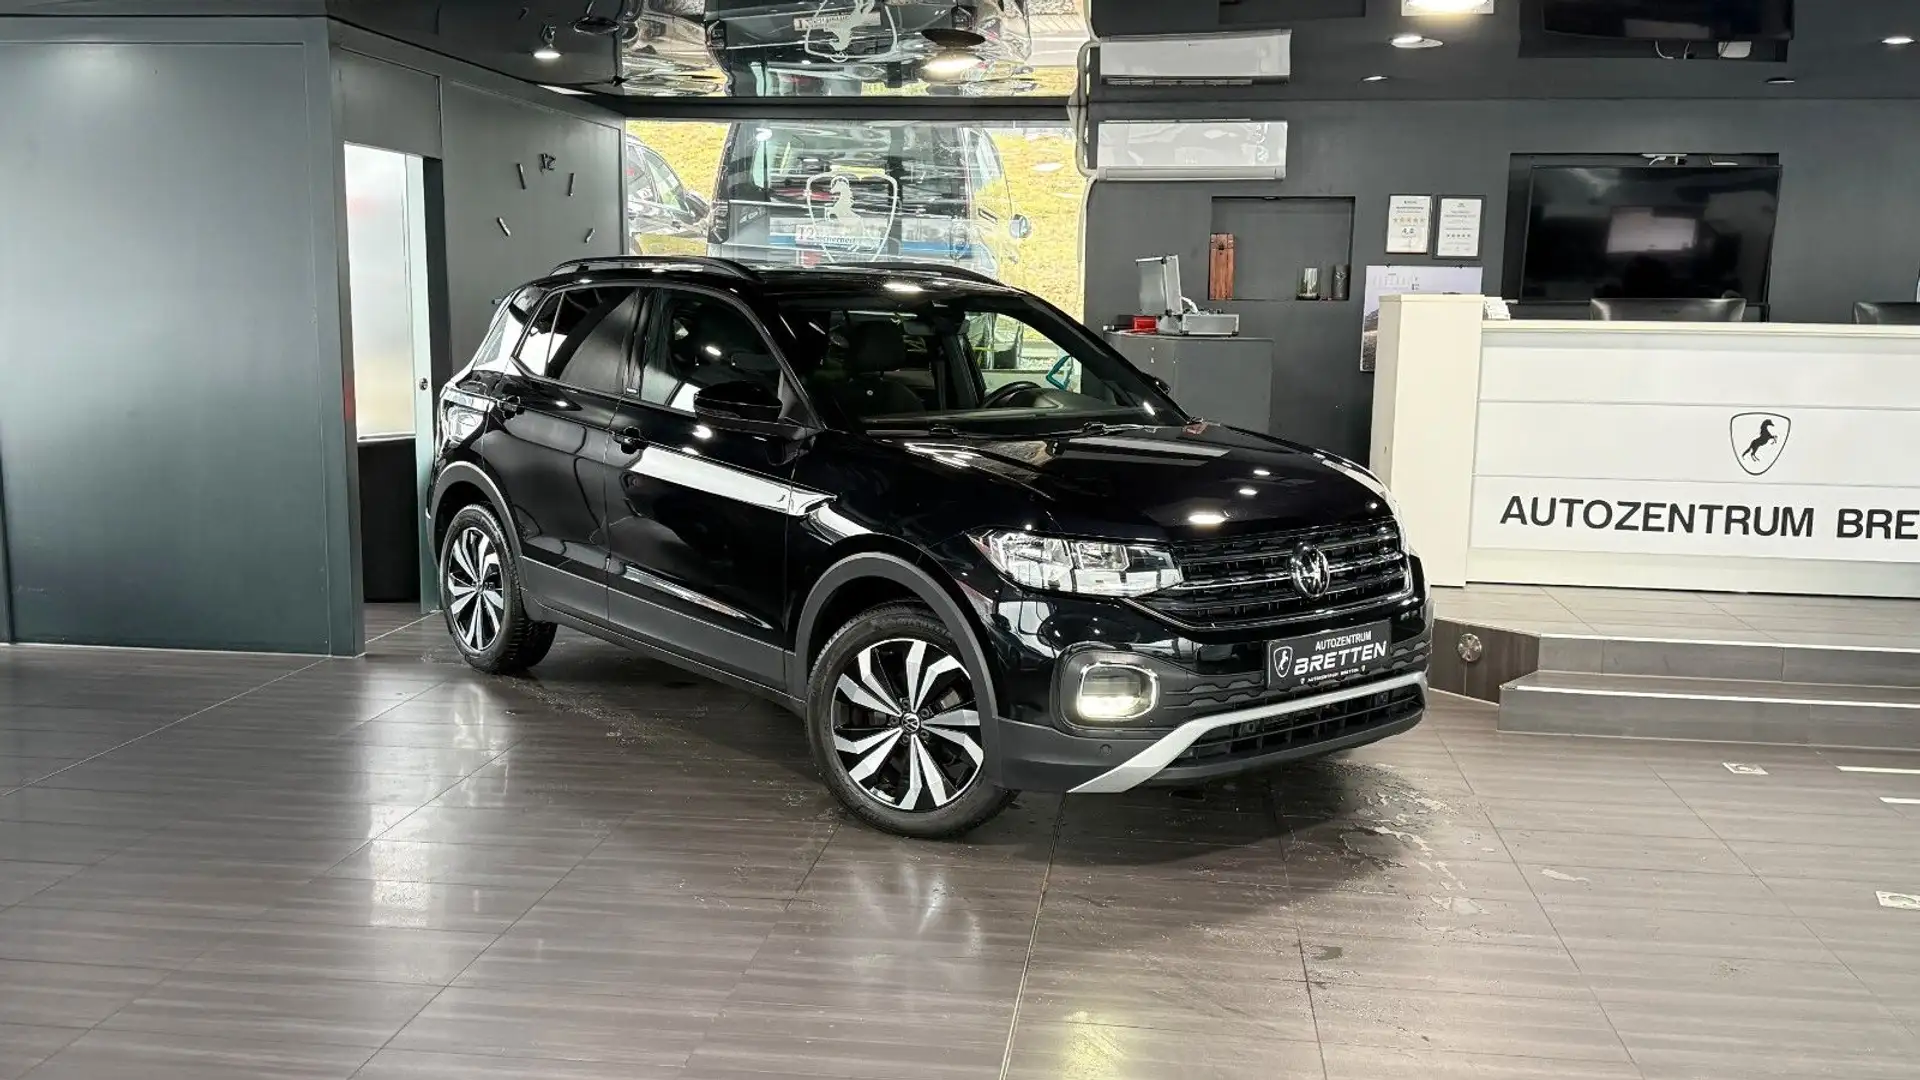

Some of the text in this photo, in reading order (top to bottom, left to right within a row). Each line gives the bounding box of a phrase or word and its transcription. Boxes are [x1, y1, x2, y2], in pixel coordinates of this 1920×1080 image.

[1500, 495, 1920, 540] AUTOZENTRUM BRE
[1293, 640, 1387, 676] BRETTEN
[1315, 630, 1372, 651] AUTOZENTRUM
